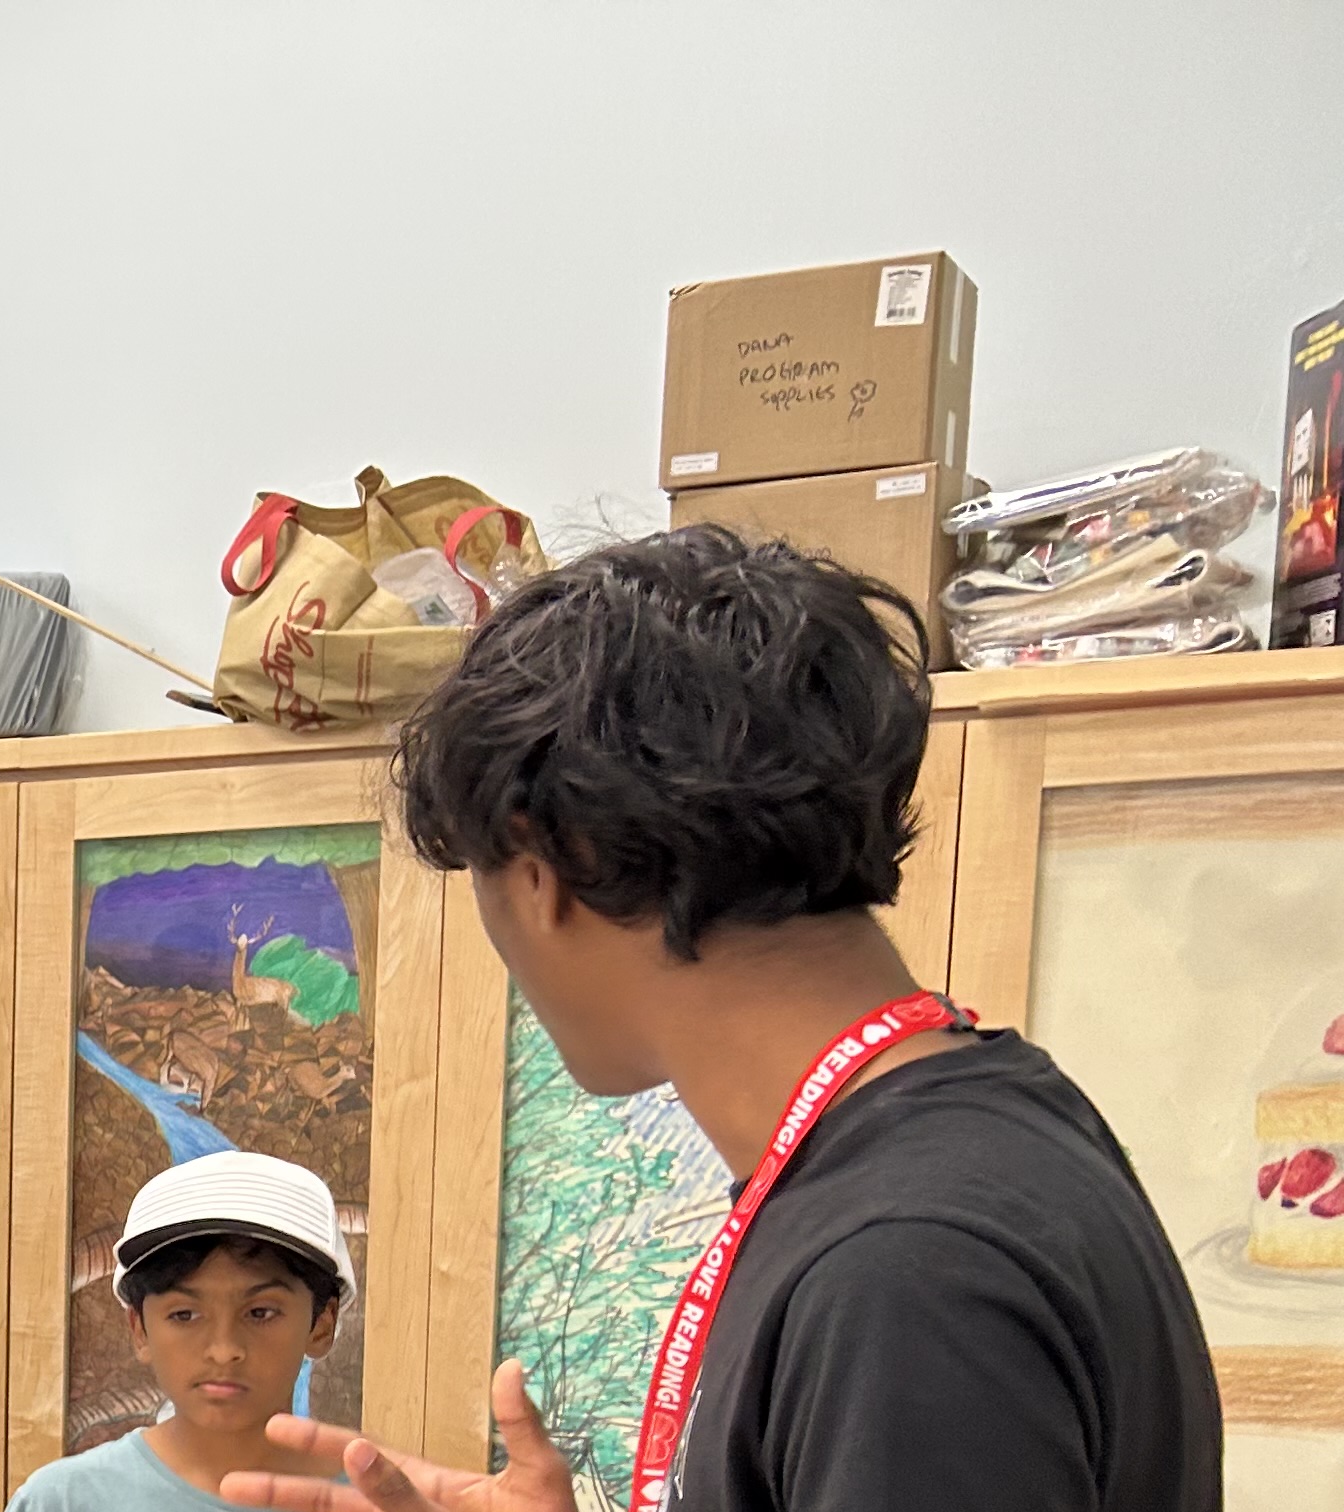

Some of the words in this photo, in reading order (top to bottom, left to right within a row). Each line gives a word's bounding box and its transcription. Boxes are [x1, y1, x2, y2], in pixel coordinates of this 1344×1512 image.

[740, 361, 839, 385] PROGRAM
[760, 385, 835, 411] SUPPLIES
[777, 1036, 860, 1155] READING!
[694, 1231, 732, 1298] LOVE
[655, 1304, 704, 1413] READING!
